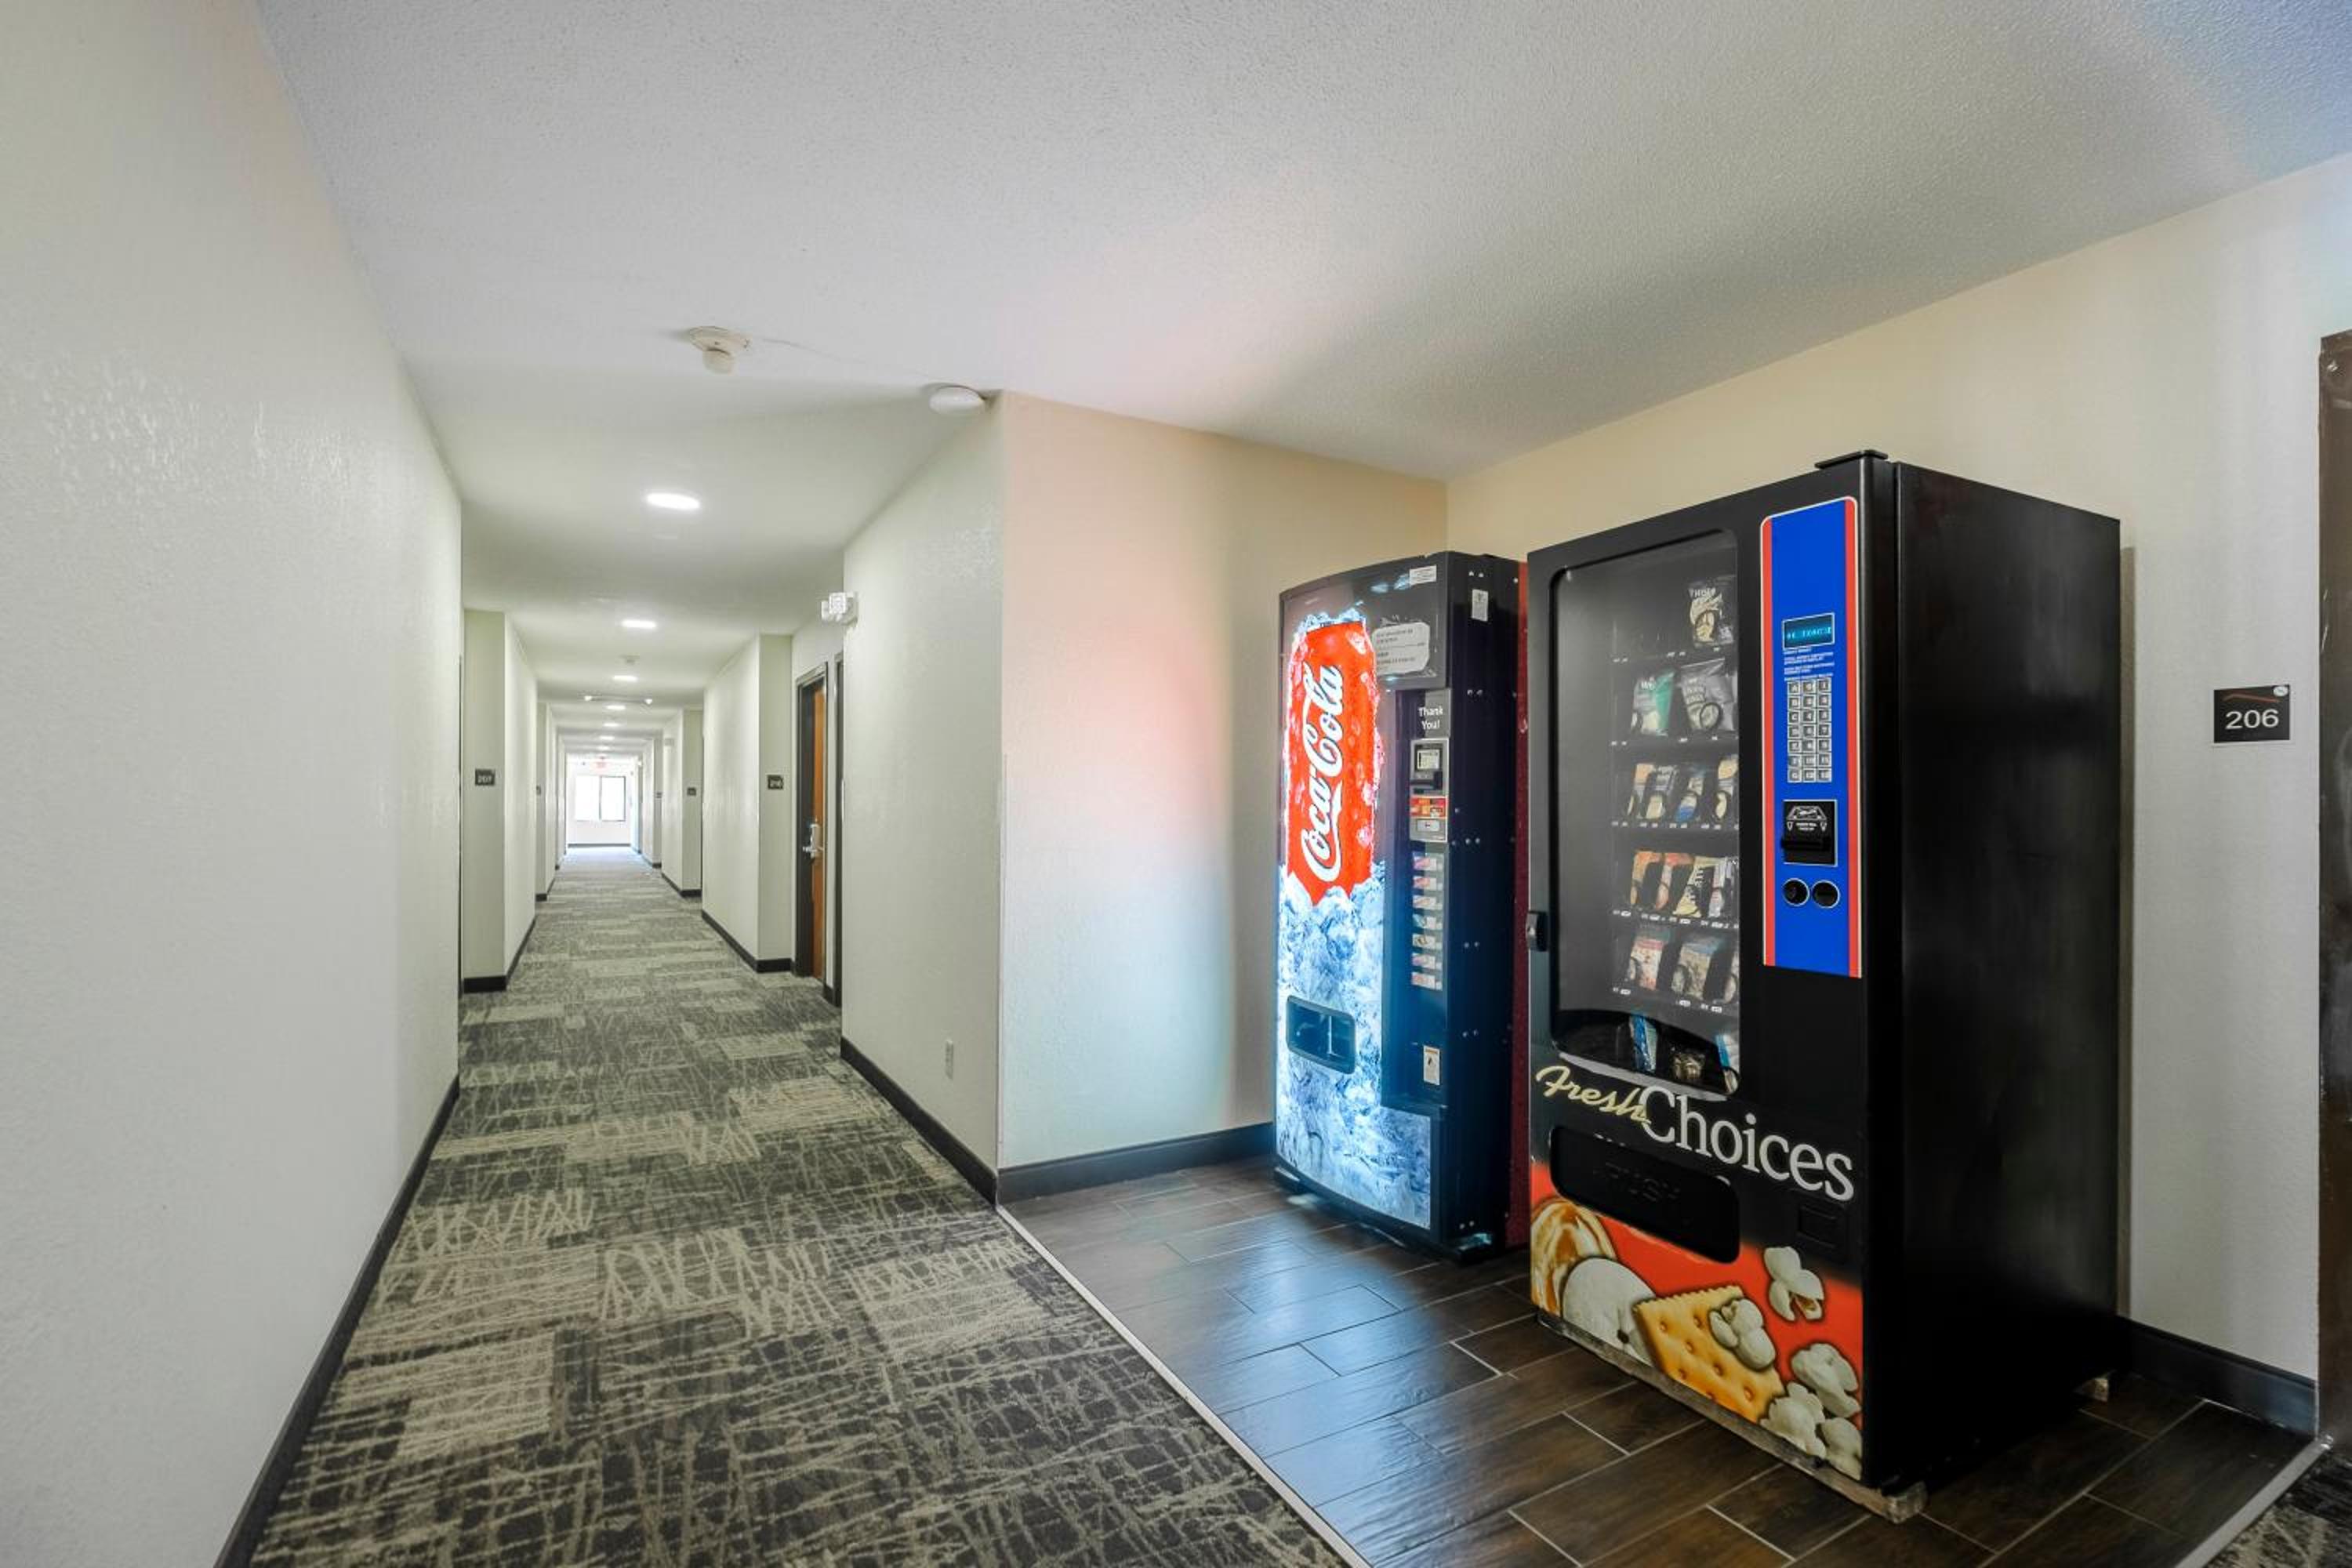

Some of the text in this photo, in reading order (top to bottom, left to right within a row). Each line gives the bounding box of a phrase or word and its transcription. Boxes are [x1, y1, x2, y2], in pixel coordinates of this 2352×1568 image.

[1418, 706, 1443, 717] Thank
[2225, 708, 2279, 729] 206
[1421, 719, 1440, 730] You!
[1536, 1065, 1652, 1124] Fresh
[1640, 1085, 1854, 1201] Choices
